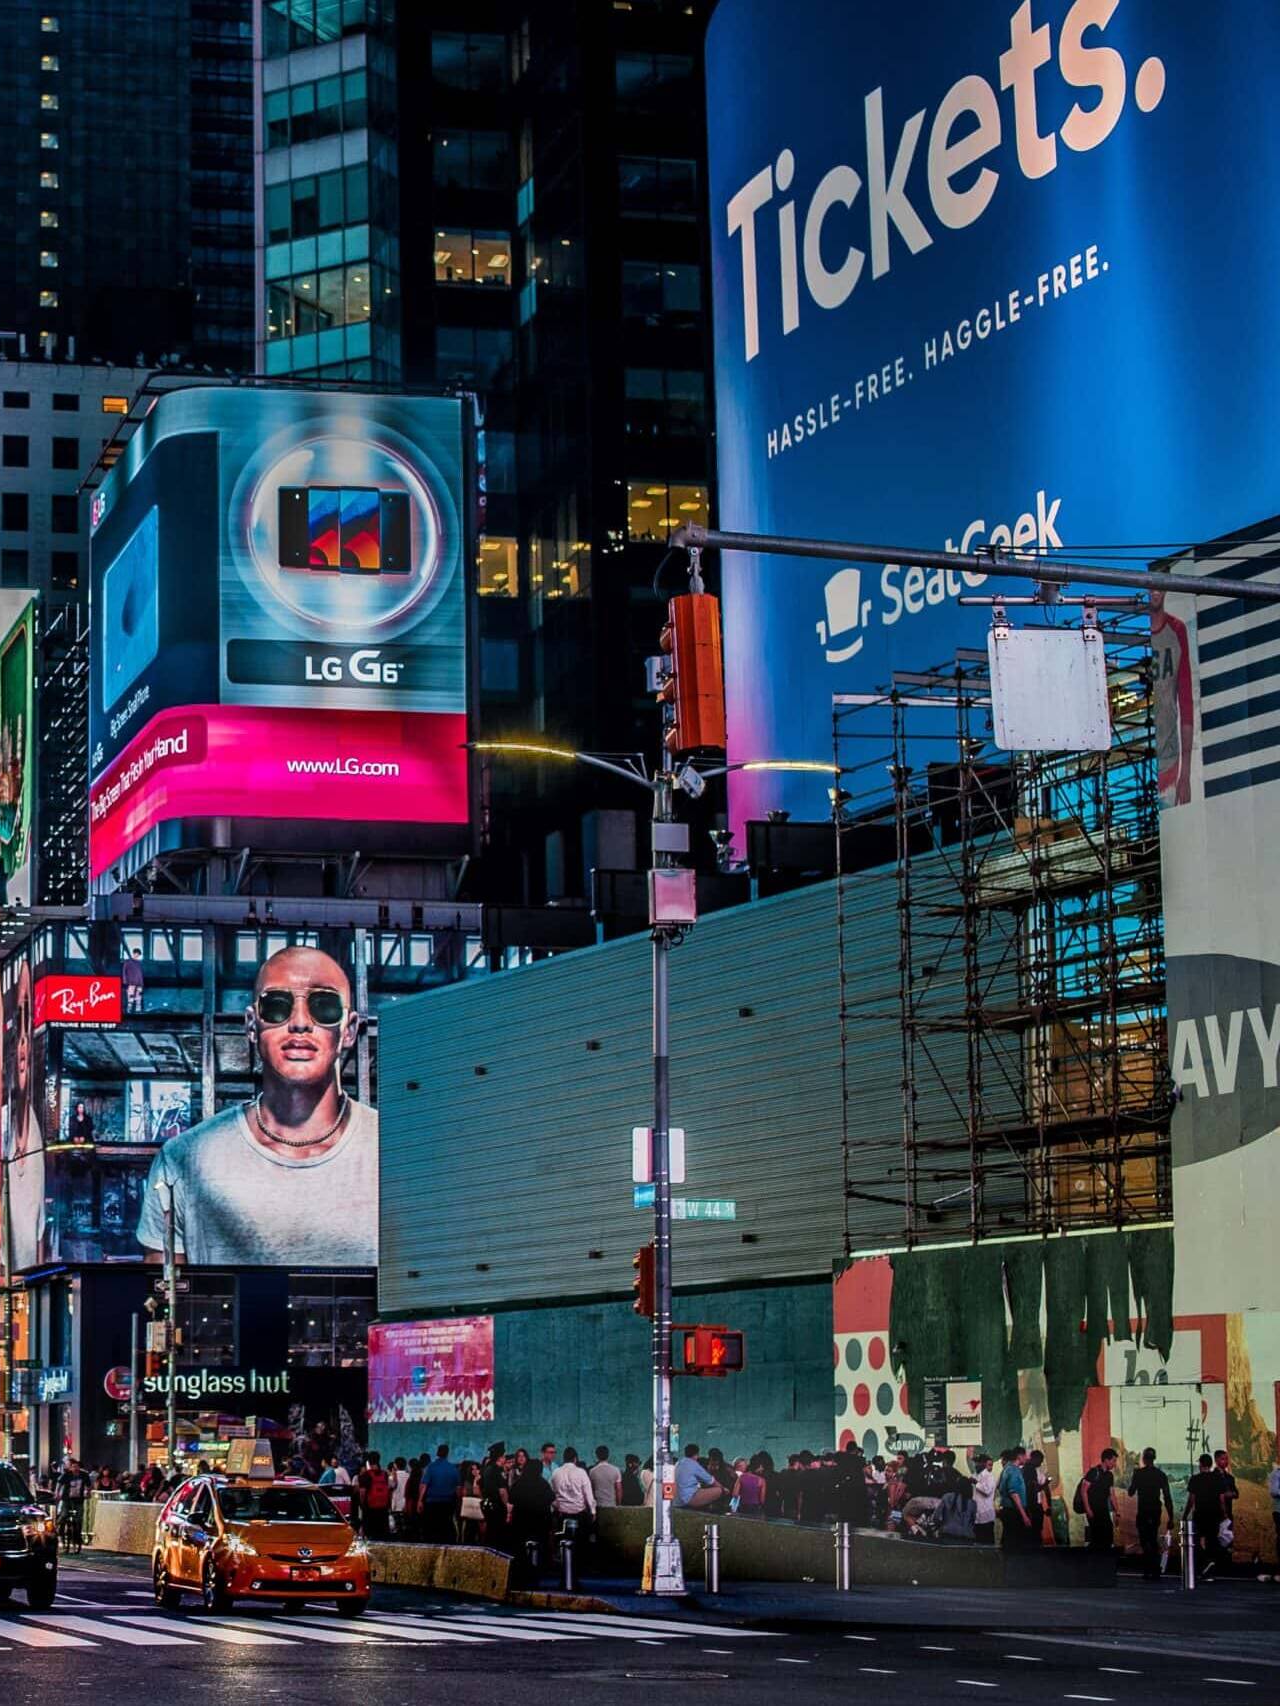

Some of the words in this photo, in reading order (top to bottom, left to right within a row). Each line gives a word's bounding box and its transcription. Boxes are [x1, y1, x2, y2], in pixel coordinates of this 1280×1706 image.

[726, 0, 1166, 363] Tickets.
[767, 355, 913, 459] HASSLE-FREE.
[925, 244, 1109, 370] HAGGLE-FREE.
[881, 490, 1063, 627] SeatGeek
[305, 656, 342, 681] LG
[154, 728, 188, 761] Hand
[287, 757, 400, 777] www.LG.com
[51, 981, 116, 1016] Ray-Ban
[687, 1201, 699, 1217] W
[704, 1201, 721, 1217] 44
[143, 1369, 246, 1399] sunglass
[250, 1369, 290, 1394] hut
